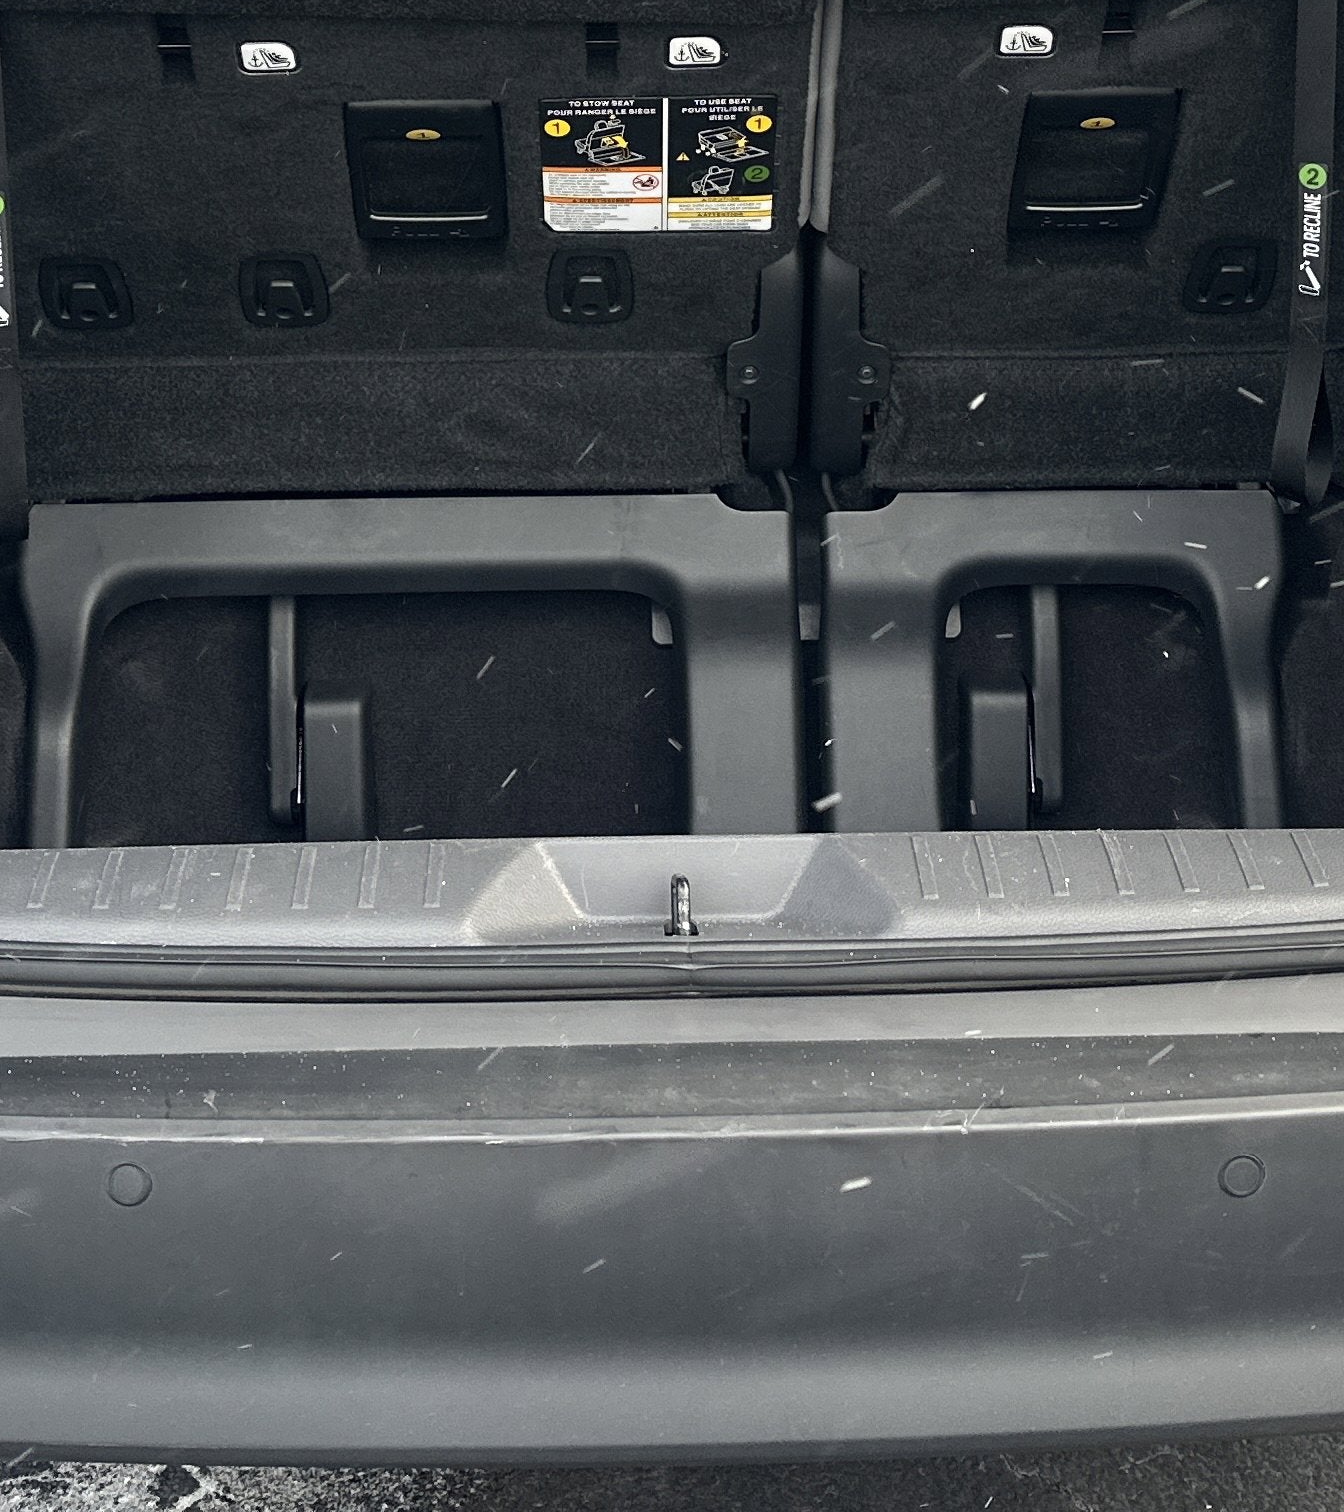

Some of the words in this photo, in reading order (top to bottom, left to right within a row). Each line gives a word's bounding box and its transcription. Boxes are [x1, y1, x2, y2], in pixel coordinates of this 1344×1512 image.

[750, 167, 763, 180] 2
[1306, 167, 1319, 186] 2
[1303, 192, 1322, 242] RECLINE
[1302, 242, 1320, 258] TO
